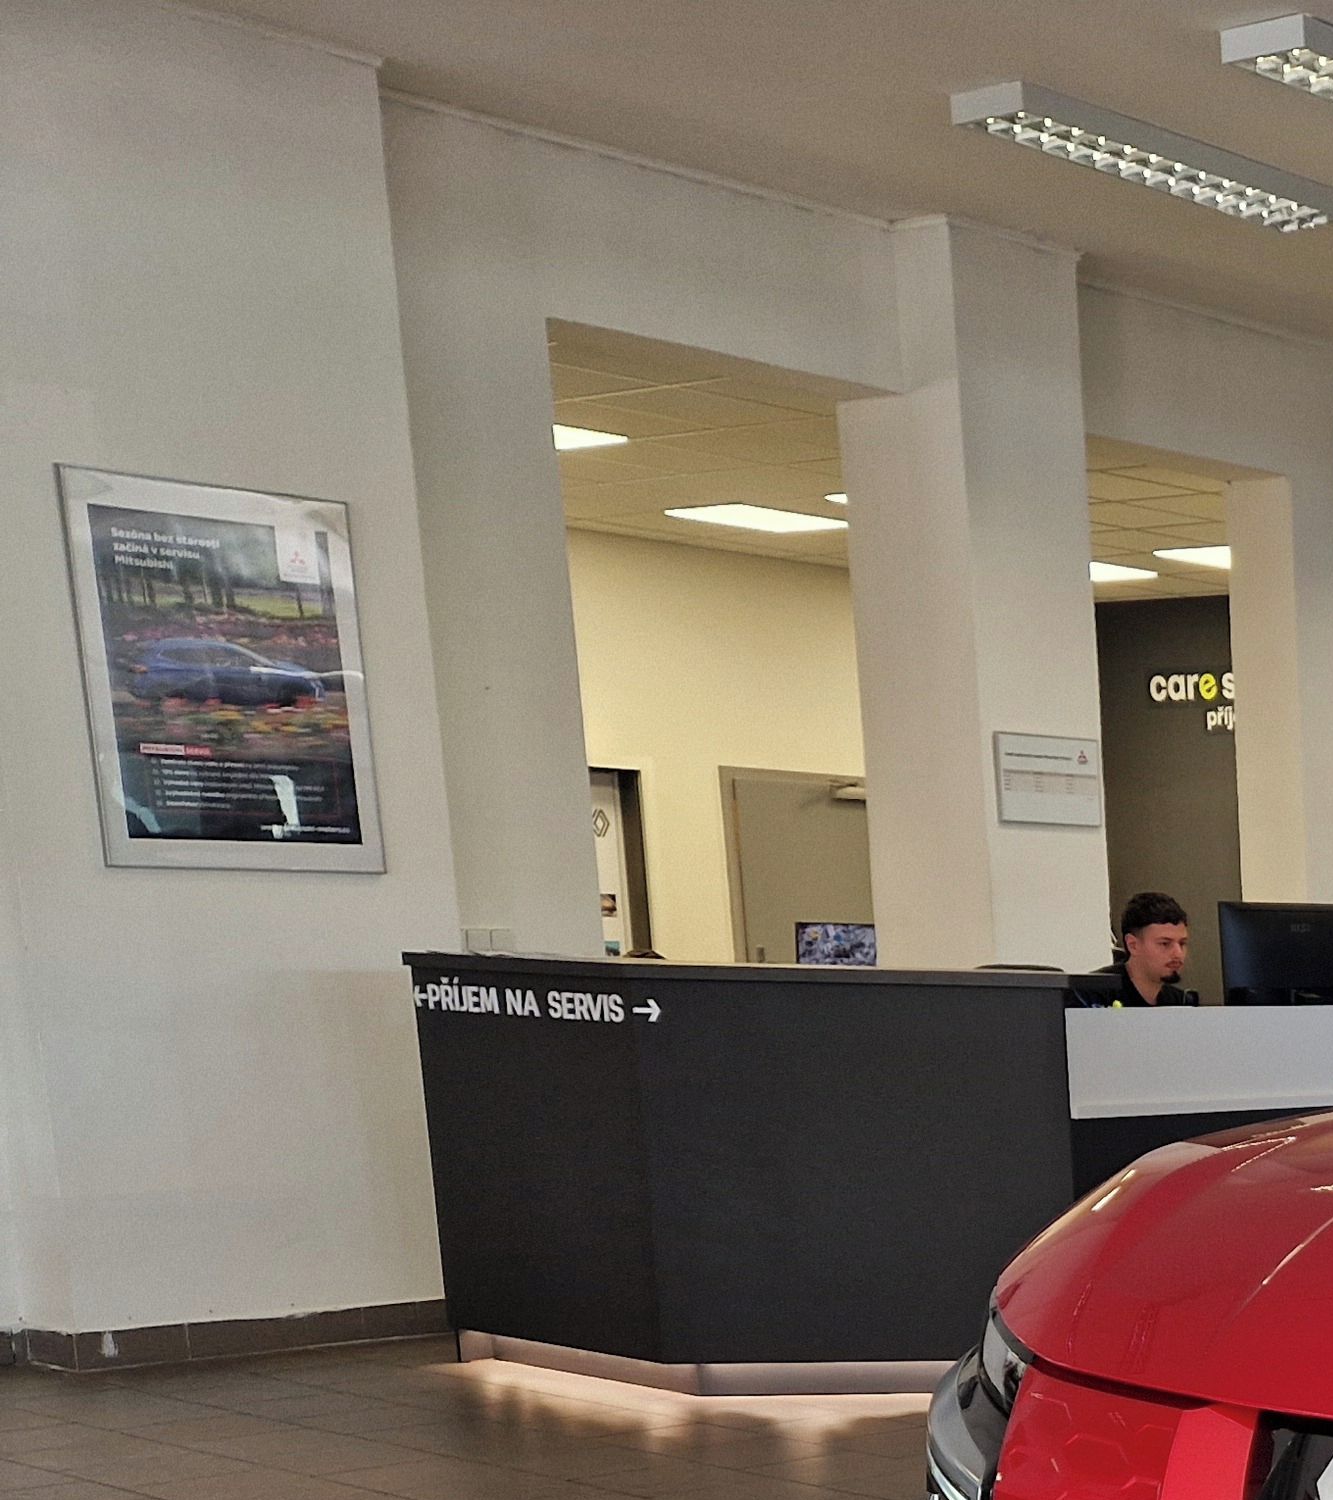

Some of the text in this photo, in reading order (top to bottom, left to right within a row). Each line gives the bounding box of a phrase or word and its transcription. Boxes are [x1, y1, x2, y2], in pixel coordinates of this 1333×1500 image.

[1149, 672, 1235, 702] care s
[1206, 705, 1235, 731] příj
[426, 975, 625, 1023] PŘÍJEM NA SERVIS
